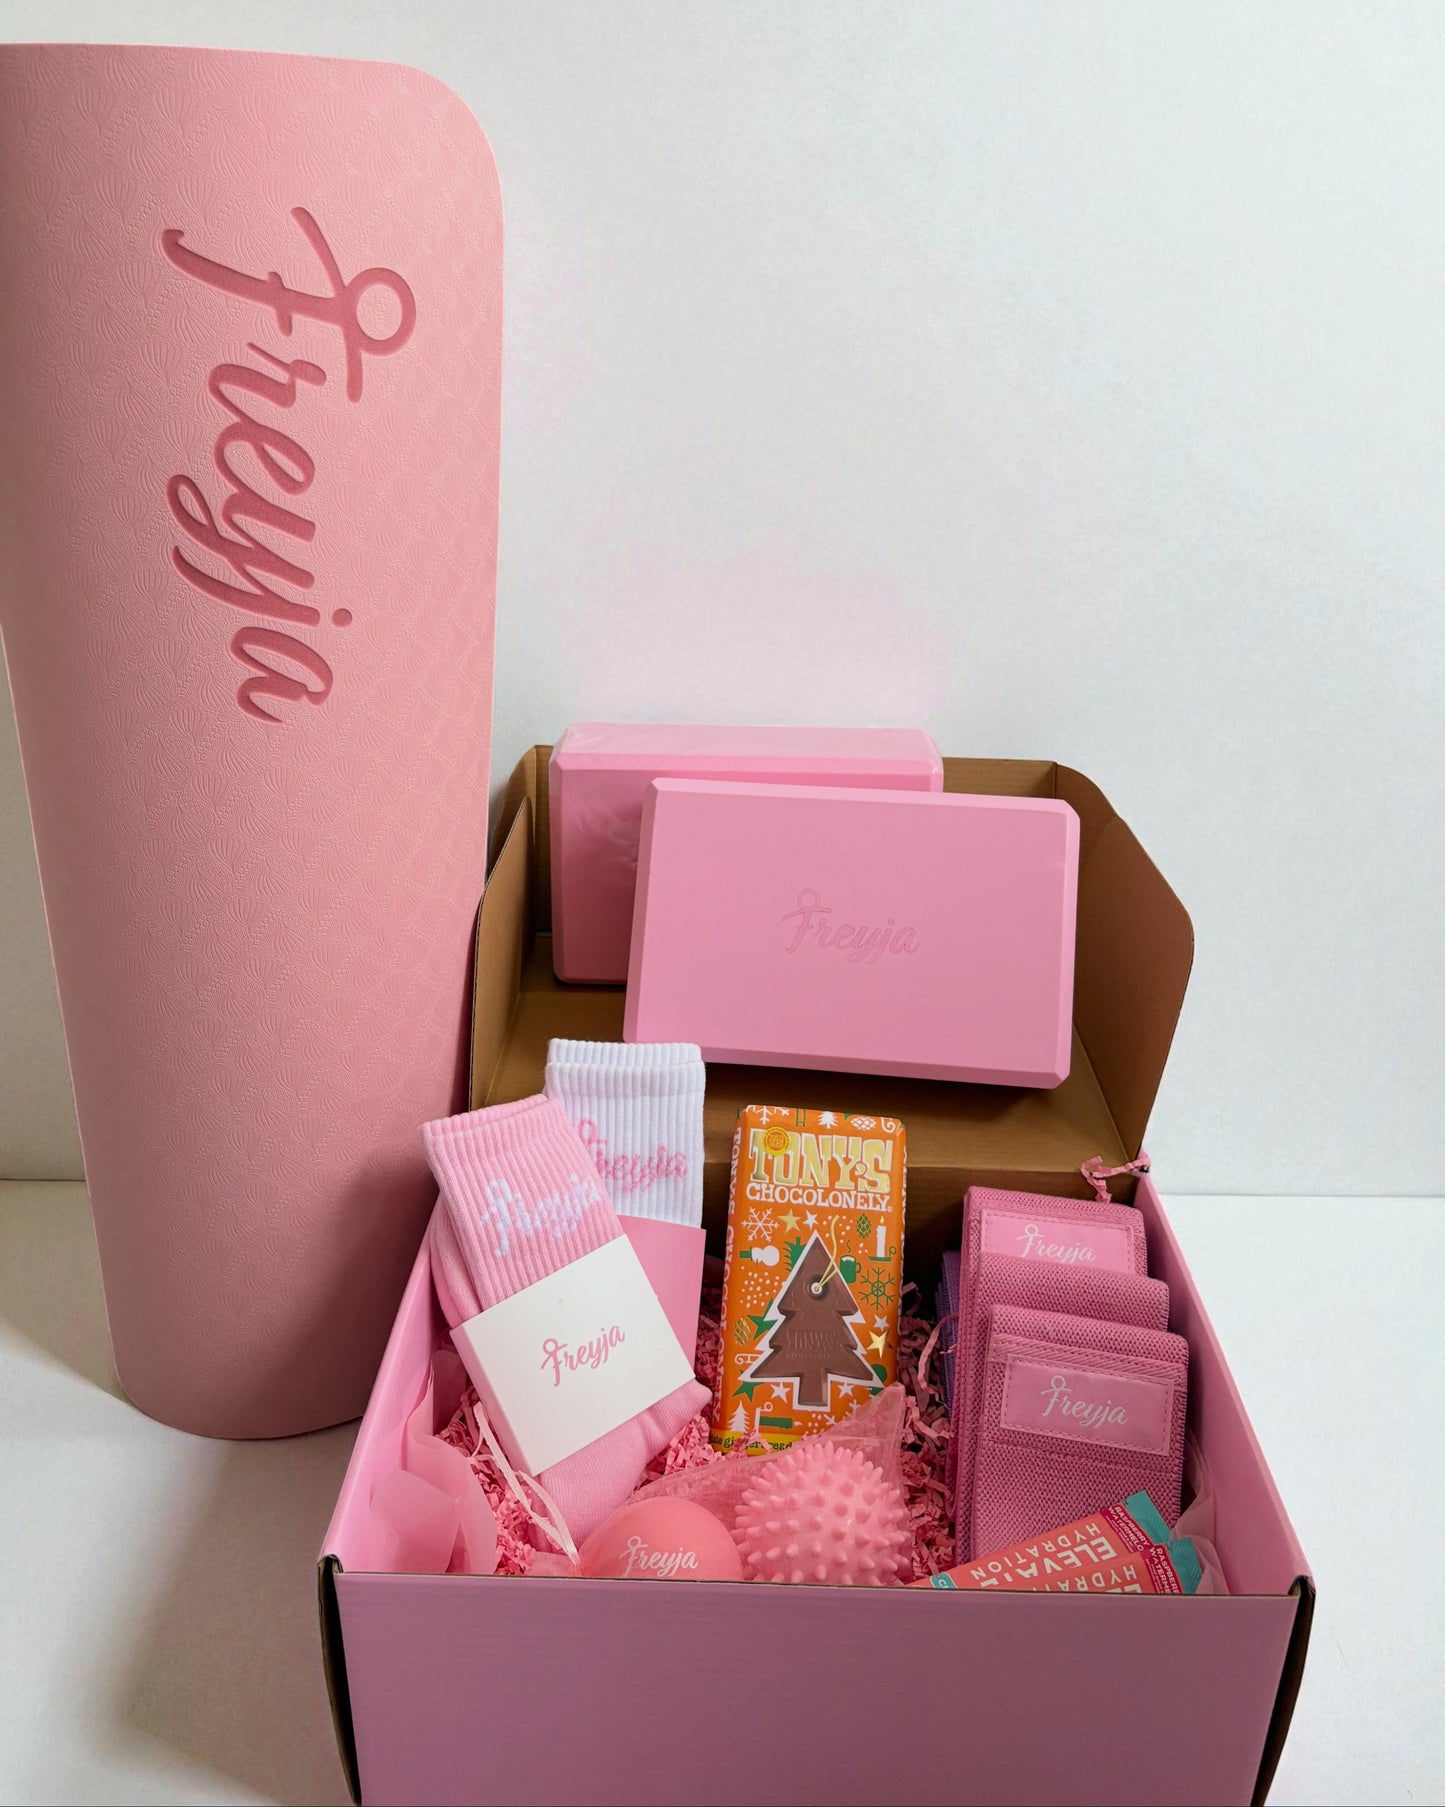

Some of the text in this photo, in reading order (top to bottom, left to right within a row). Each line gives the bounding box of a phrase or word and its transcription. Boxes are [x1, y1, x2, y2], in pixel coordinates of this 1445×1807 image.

[161, 206, 416, 724] Freyja
[781, 887, 920, 965] Freyja
[750, 1127, 893, 1194] TONY'S
[745, 1183, 890, 1212] CHOCOLONELY
[1016, 1223, 1096, 1265] Freyja
[540, 1325, 625, 1387] Freyja
[1040, 1375, 1128, 1428] Freyja
[970, 1522, 1101, 1580] HYDRATION
[1114, 1506, 1151, 1546] RASPBERRY
[619, 1535, 699, 1578] Freyja
